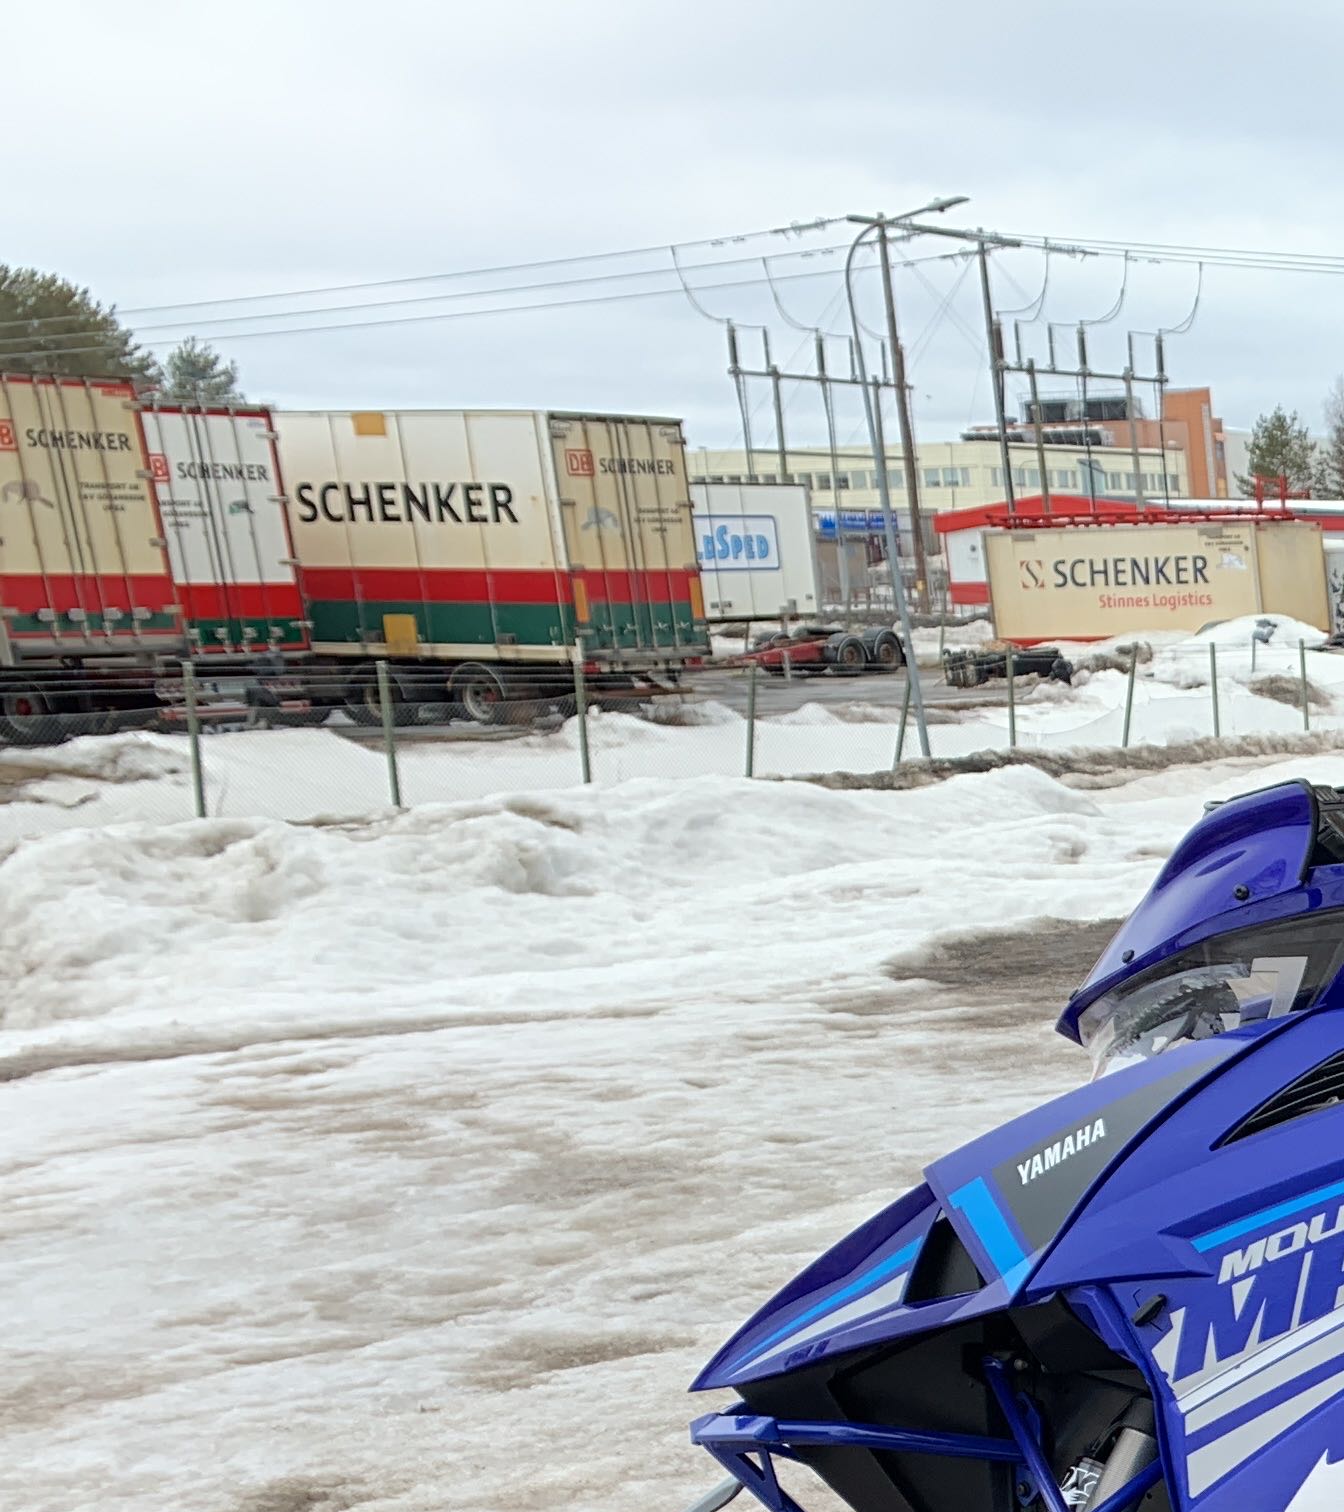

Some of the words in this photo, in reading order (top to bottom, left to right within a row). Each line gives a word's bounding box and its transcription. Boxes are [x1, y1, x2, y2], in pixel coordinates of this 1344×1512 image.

[26, 428, 132, 451] SCHENKER
[176, 461, 269, 481] SCHENKER
[599, 457, 675, 475] SCHENKER
[296, 482, 519, 523] SCHENKER
[1053, 555, 1210, 588] SCHENKER
[1099, 595, 1150, 609] Stinnes
[1152, 592, 1213, 611] Logistics
[1016, 1118, 1105, 1185] YAMAHA
